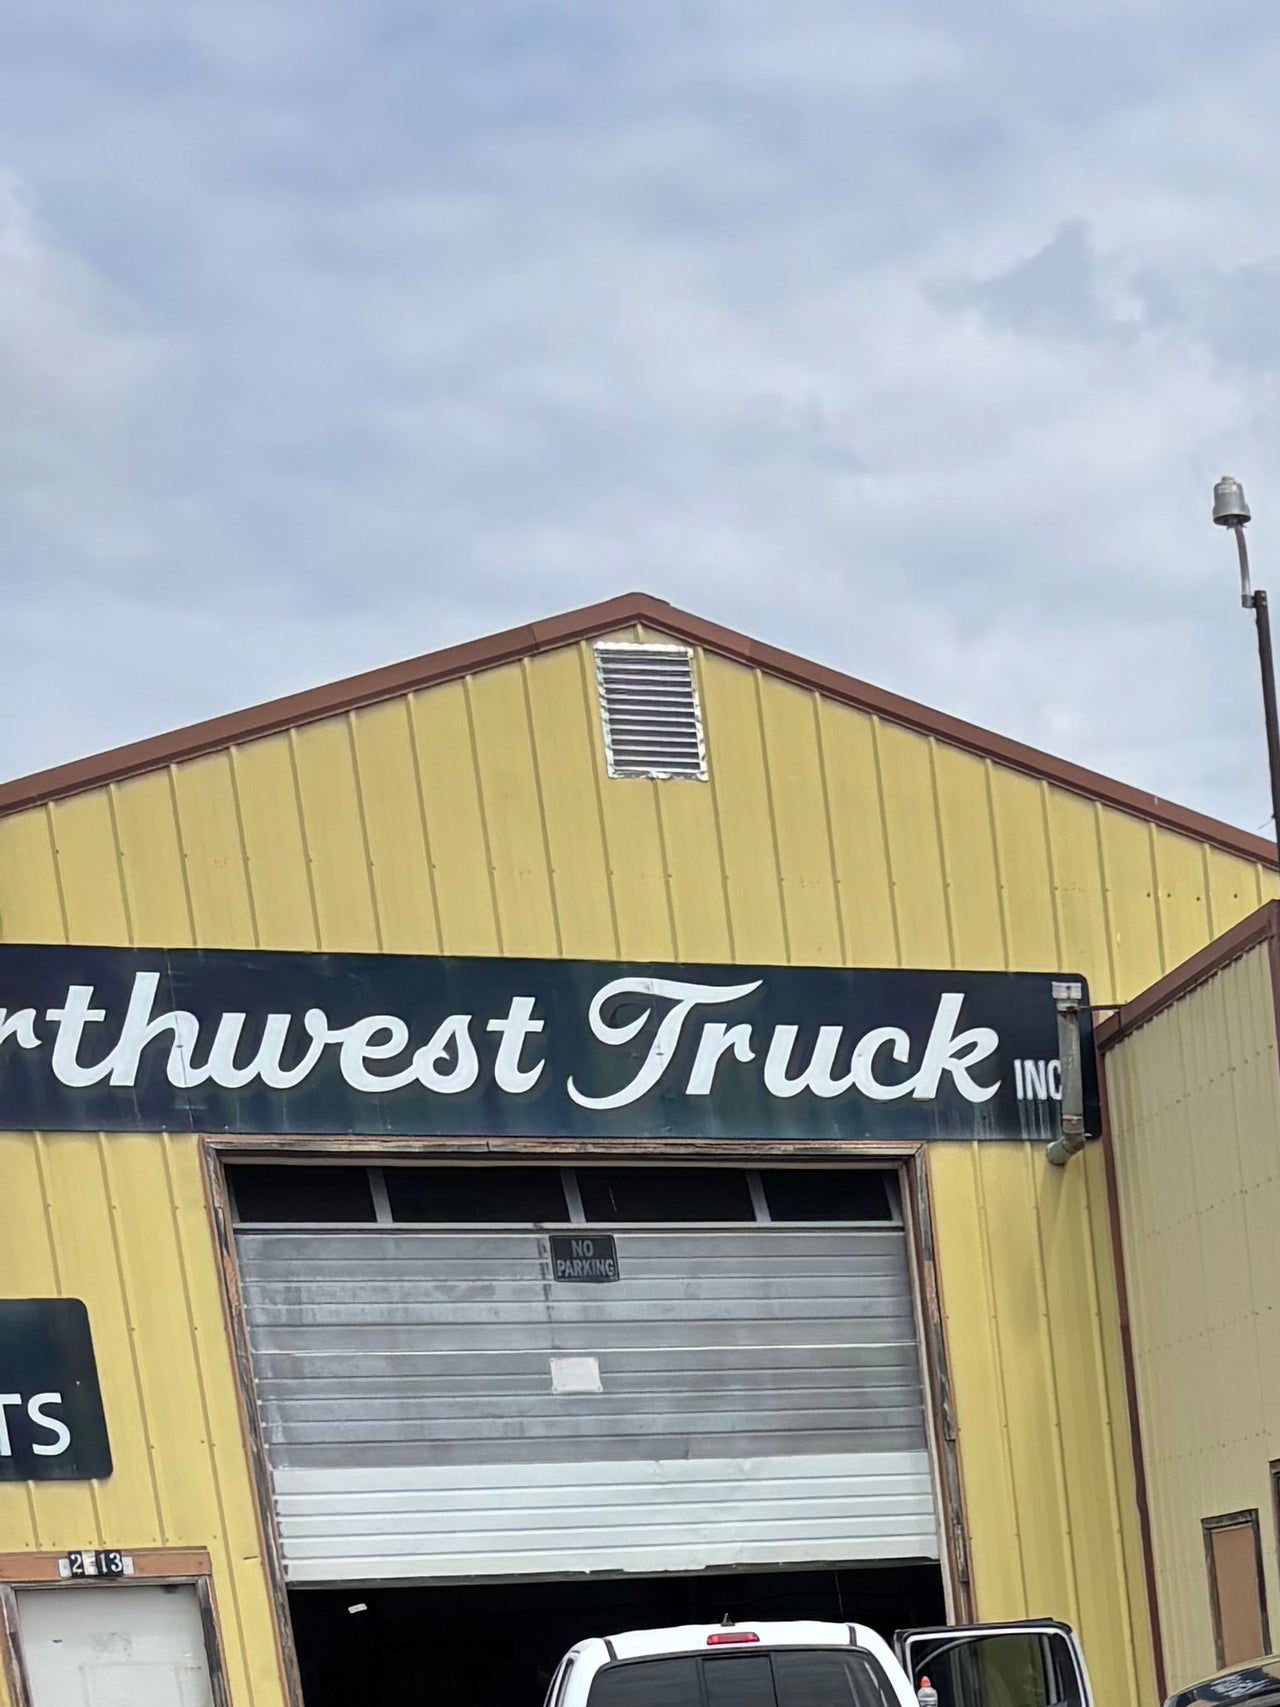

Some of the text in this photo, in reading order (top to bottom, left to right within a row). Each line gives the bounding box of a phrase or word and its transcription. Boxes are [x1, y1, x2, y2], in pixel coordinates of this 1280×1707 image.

[567, 977, 1001, 1109] Truck
[571, 1240, 593, 1257] NO
[556, 1259, 614, 1277] PARKING
